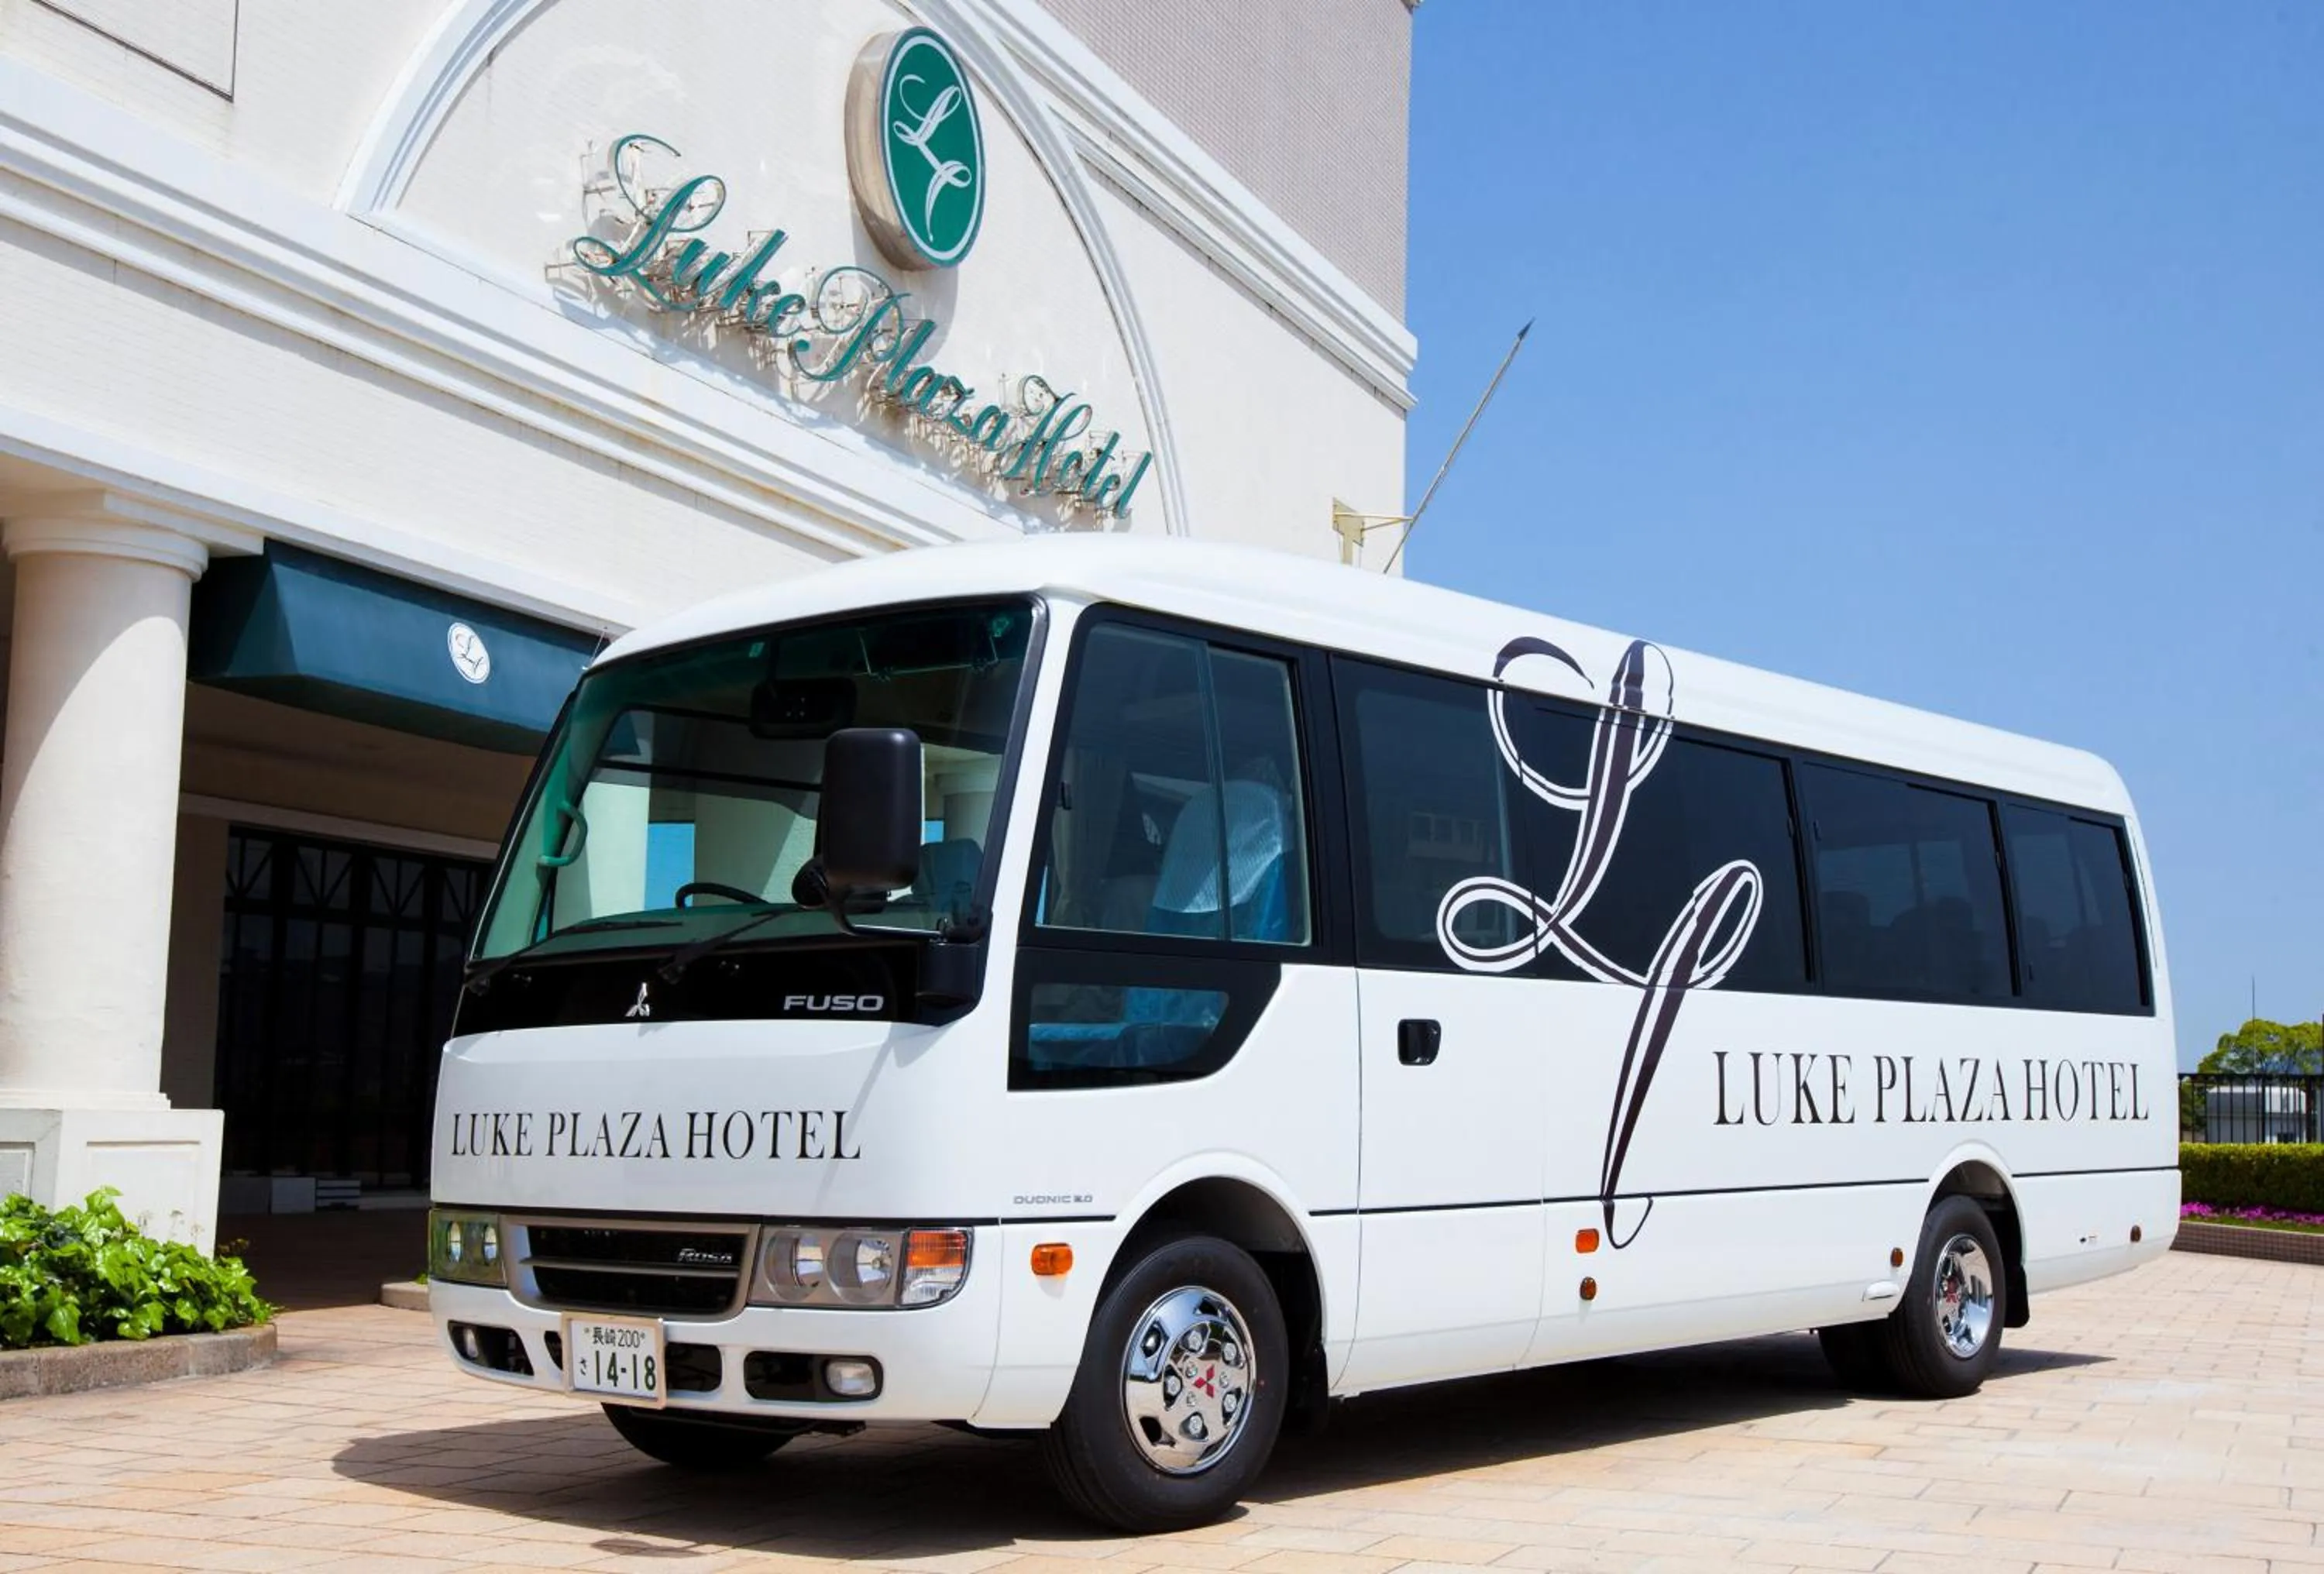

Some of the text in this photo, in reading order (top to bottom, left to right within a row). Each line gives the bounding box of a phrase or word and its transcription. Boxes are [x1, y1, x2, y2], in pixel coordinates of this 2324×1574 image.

[572, 133, 1152, 520] Luke Plaza Hotel
[783, 995, 884, 1011] FUSO
[1713, 1050, 2150, 1126] LUKE PLAZA HOTEL
[451, 1109, 861, 1160] LUKE PLAZA HOTEL
[1013, 1194, 1071, 1205] DUONIC
[595, 1350, 656, 1391] 14-18
